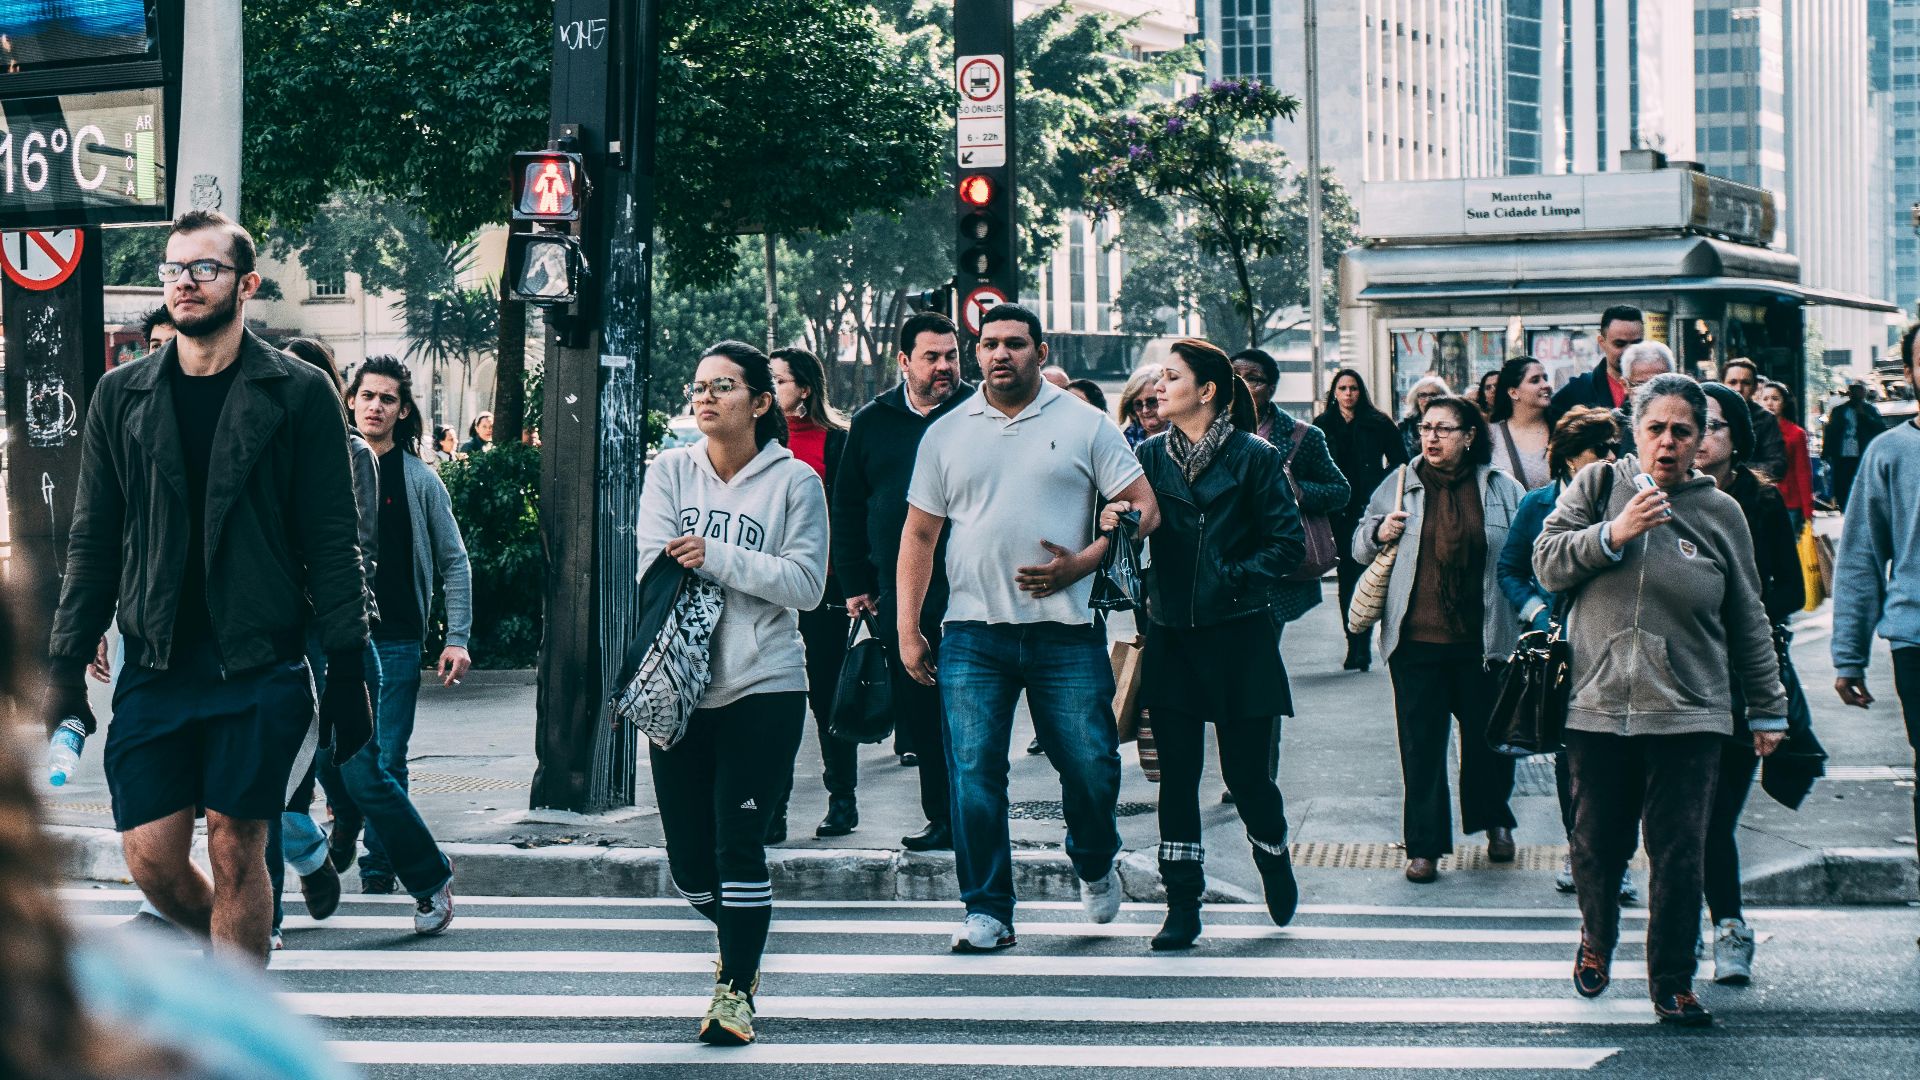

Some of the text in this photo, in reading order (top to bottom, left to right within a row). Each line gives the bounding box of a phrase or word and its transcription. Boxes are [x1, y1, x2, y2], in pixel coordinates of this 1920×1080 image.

[136, 115, 152, 130] AR
[967, 134, 973, 142] 6
[982, 133, 999, 141] 22h
[1491, 190, 1552, 202] Mantenha
[1466, 205, 1581, 219] Sua Cidade Limpa
